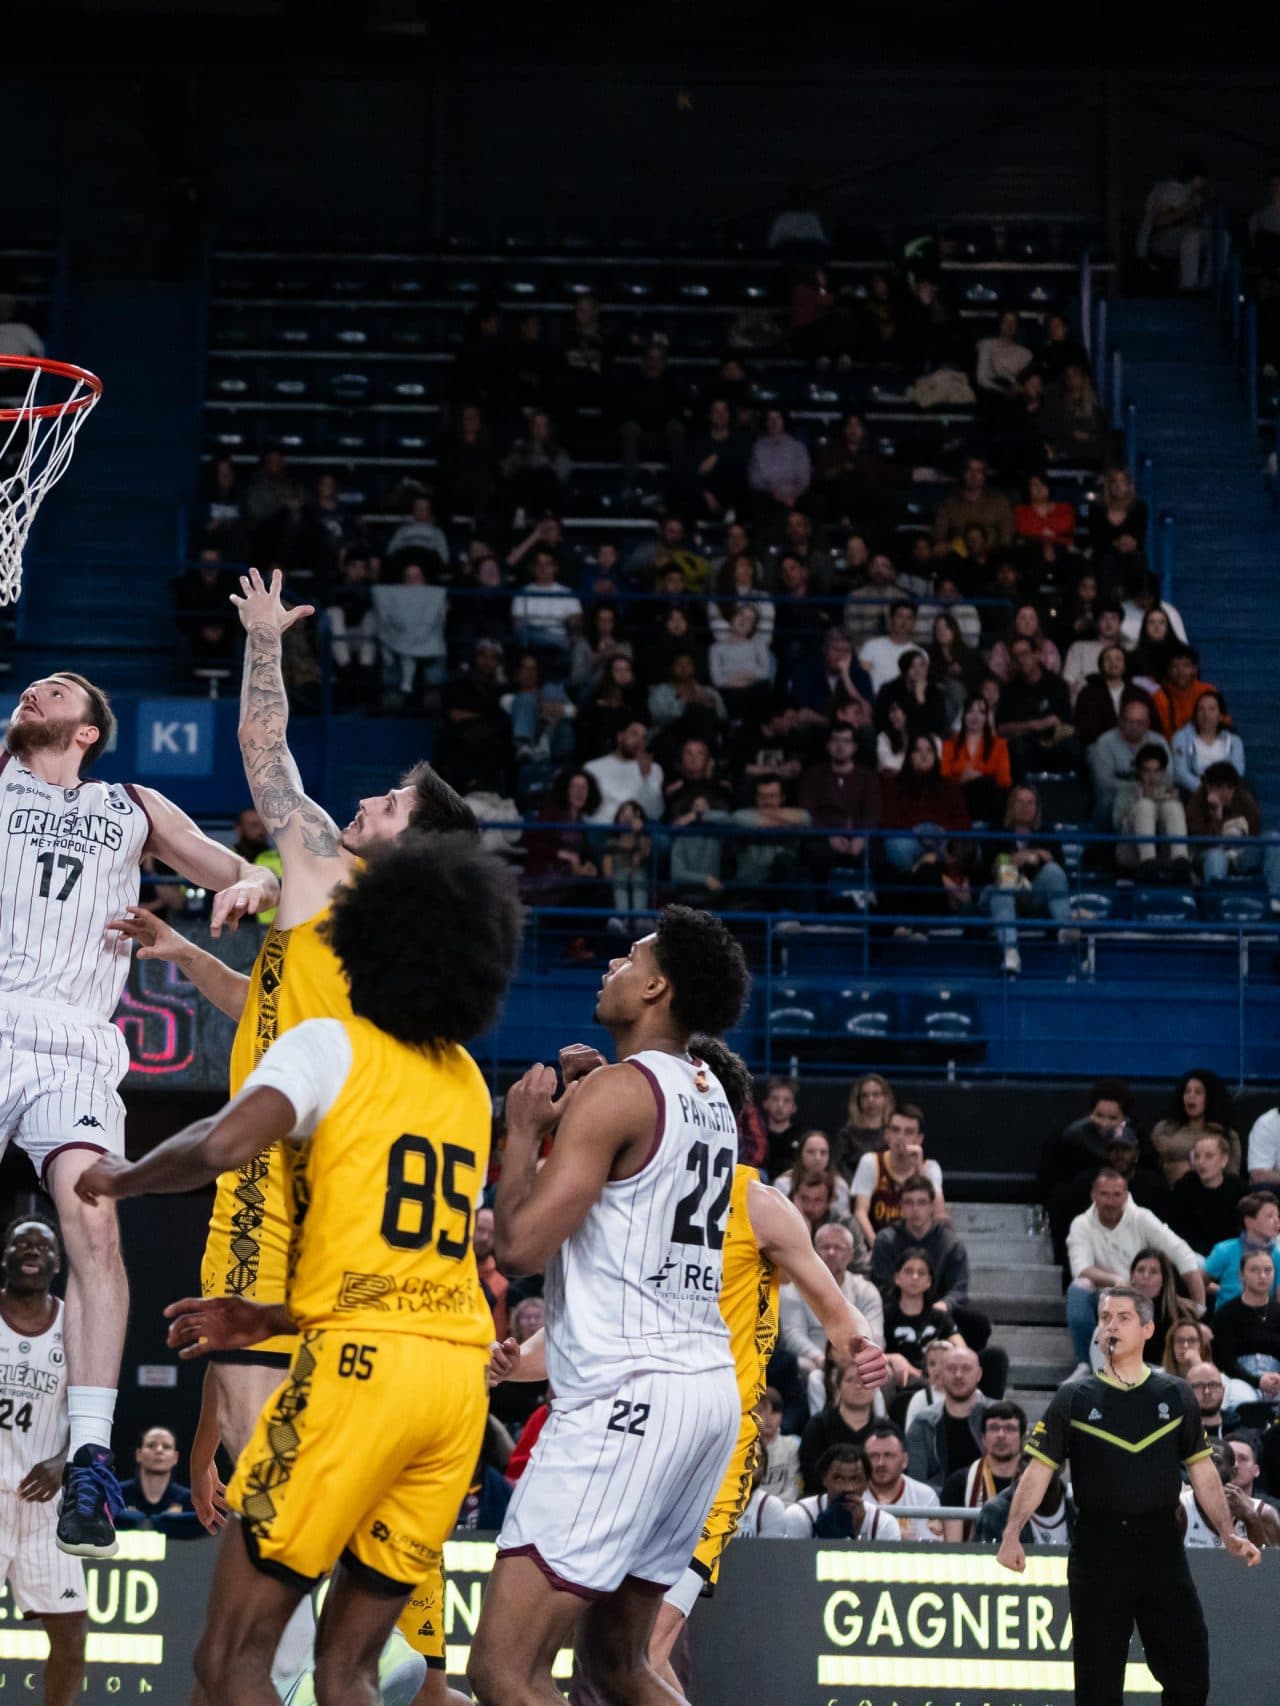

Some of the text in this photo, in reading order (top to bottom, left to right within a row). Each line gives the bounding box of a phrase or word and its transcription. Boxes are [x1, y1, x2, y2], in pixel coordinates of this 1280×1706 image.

[152, 721, 199, 754] K1
[7, 807, 124, 852] ORLÉANS
[36, 851, 84, 902] 17
[380, 1132, 477, 1263] 85
[670, 1140, 734, 1251] 22
[337, 1342, 379, 1382] 85
[607, 1399, 651, 1437] 22
